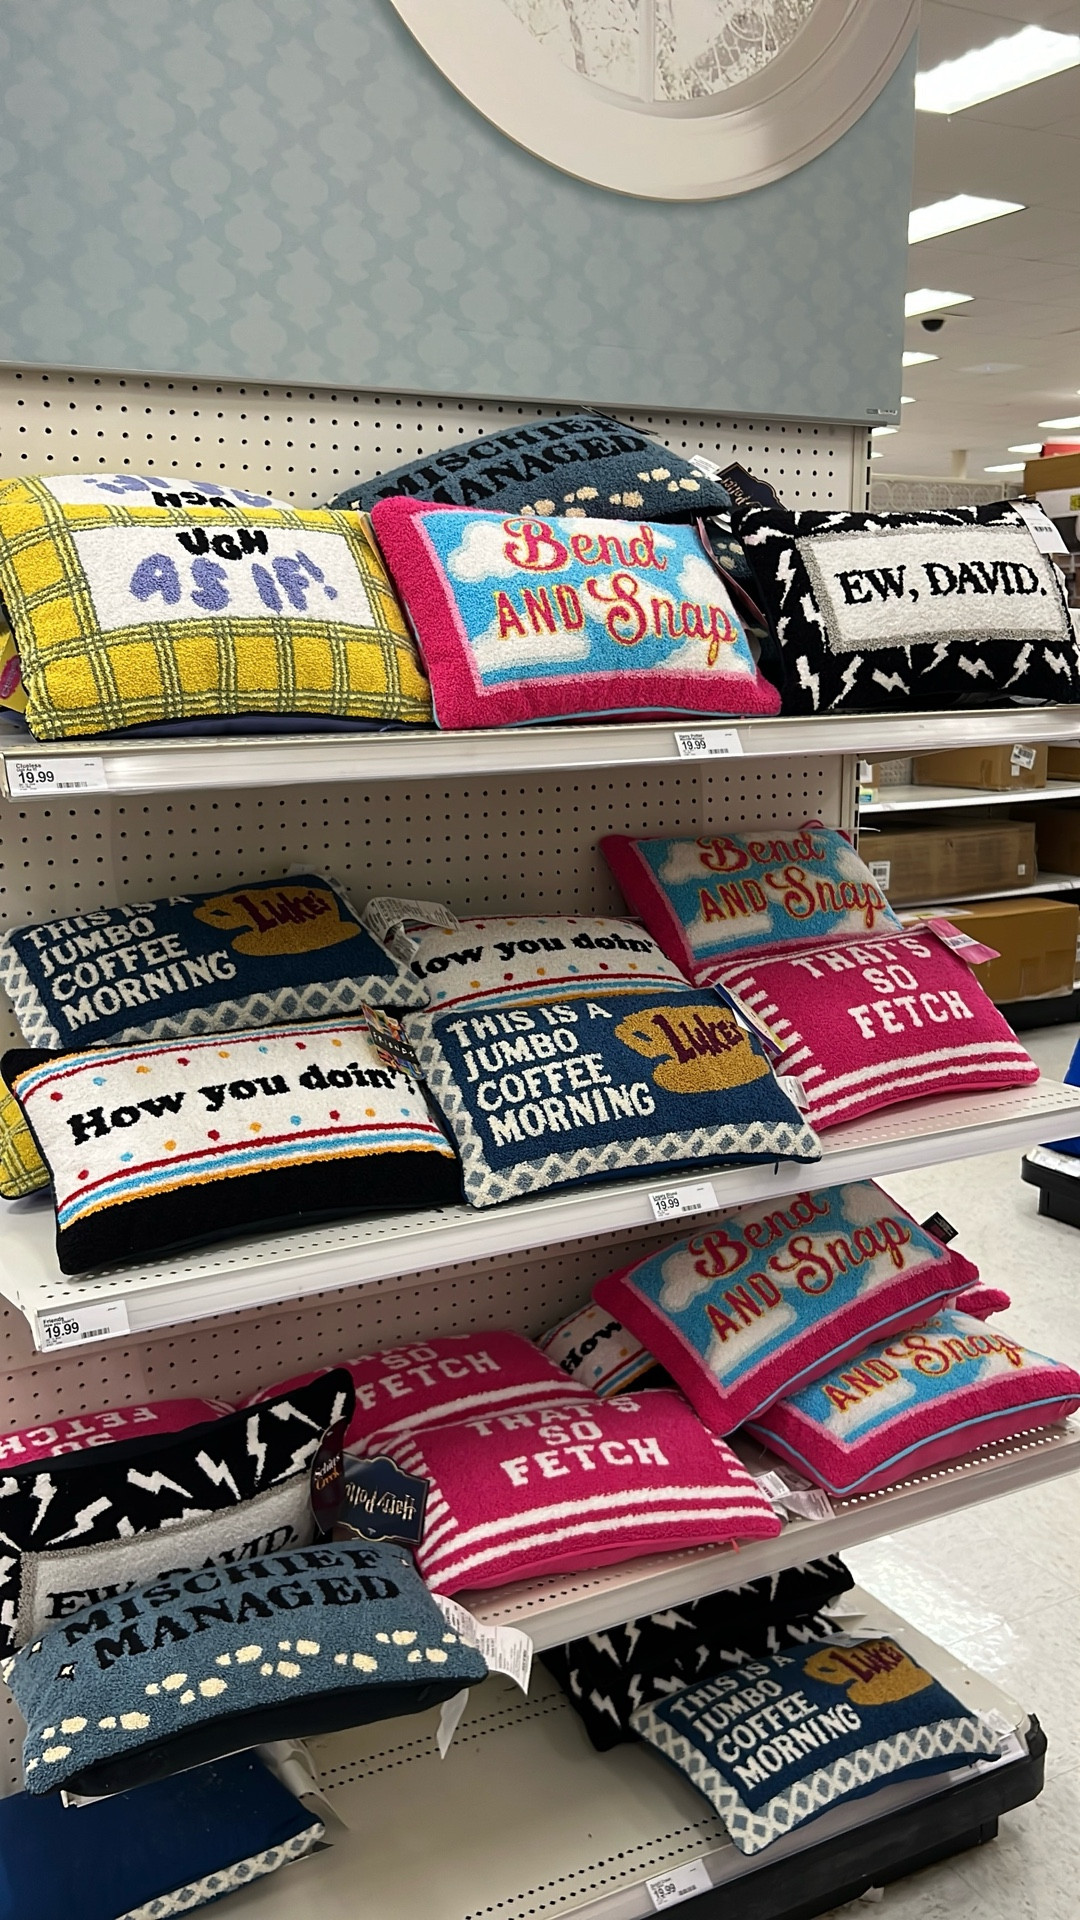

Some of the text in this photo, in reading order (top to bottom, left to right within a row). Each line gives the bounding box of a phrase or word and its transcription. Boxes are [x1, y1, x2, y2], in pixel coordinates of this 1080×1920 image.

[176, 528, 269, 560] UGH
[503, 518, 666, 572] Bend
[129, 550, 338, 613] AS IF!
[834, 560, 1047, 605] EW, DAVID.
[497, 573, 739, 668] AND Snap
[682, 740, 707, 750] 19.99
[19, 771, 54, 783] 19.99
[696, 835, 827, 873] Bend
[699, 865, 887, 929] AND Snap
[22, 906, 112, 951] THIS
[114, 901, 157, 926] IS
[40, 915, 155, 977] JUMBO
[502, 934, 566, 970] you
[51, 932, 190, 1001] COFFEE
[789, 937, 932, 979] THAT'S
[862, 965, 919, 994] SO
[61, 950, 238, 1031] MORNING
[847, 990, 974, 1040] FETCH
[446, 1002, 613, 1048] THIS IS A
[462, 1028, 579, 1083] JUMBO
[476, 1052, 611, 1113] COFFEE
[66, 1091, 187, 1146] How
[198, 1072, 290, 1113] you
[486, 1081, 656, 1147] MORNING
[656, 1198, 680, 1211] 19.99
[687, 1189, 828, 1280] Bend
[703, 1213, 911, 1342] AND Snap
[45, 1322, 79, 1339] 19.99
[381, 1348, 438, 1370] SO
[559, 1321, 622, 1374] How
[355, 1351, 502, 1410] FETCH
[822, 1334, 1023, 1413] AND Snap
[538, 1420, 603, 1446] SO
[500, 1437, 669, 1487] FETCH
[60, 1549, 385, 1647] MISCHIEF
[93, 1575, 400, 1670] MANAGED
[671, 1655, 796, 1719] THIS IS A
[693, 1680, 783, 1742] JUMBO
[715, 1690, 820, 1764] COFFEE
[731, 1703, 862, 1790] MORNING
